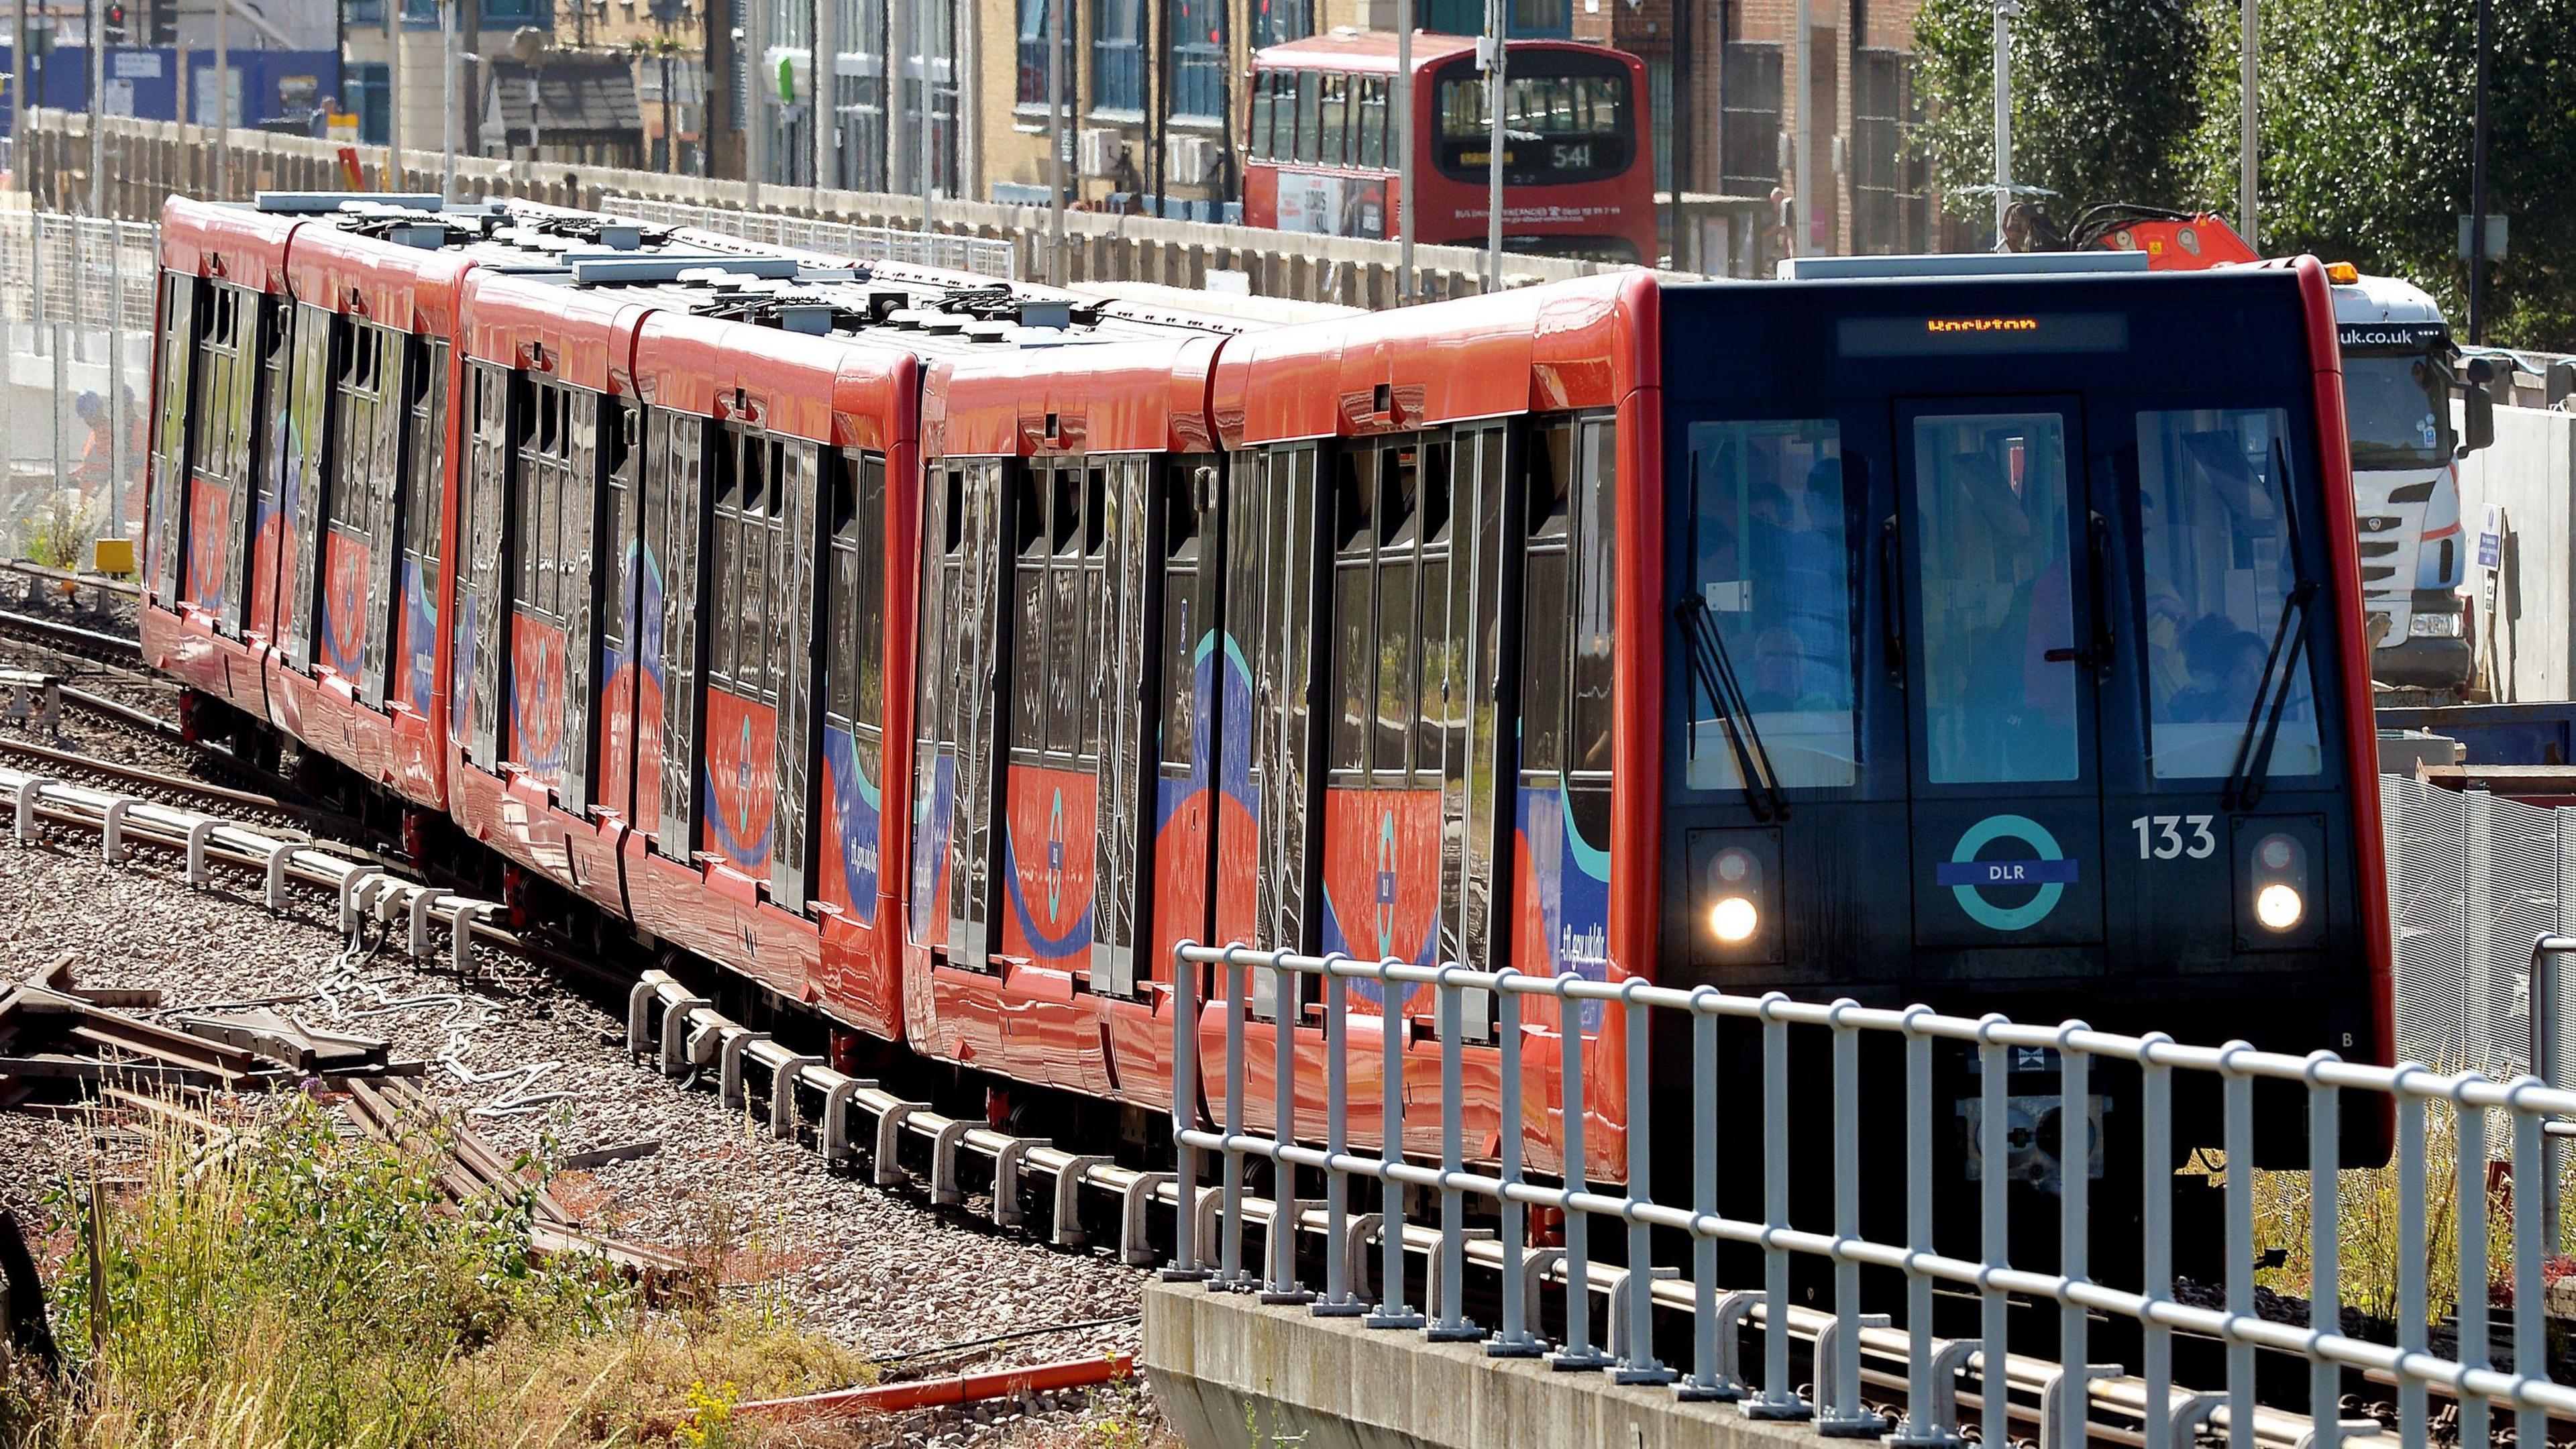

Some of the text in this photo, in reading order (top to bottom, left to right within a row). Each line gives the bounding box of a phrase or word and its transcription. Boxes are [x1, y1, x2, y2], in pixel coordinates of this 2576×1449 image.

[1552, 144, 1591, 168] 541
[2132, 815, 2215, 860] 133
[1989, 865, 2025, 880] DLR
[2343, 1032, 2353, 1047] B
